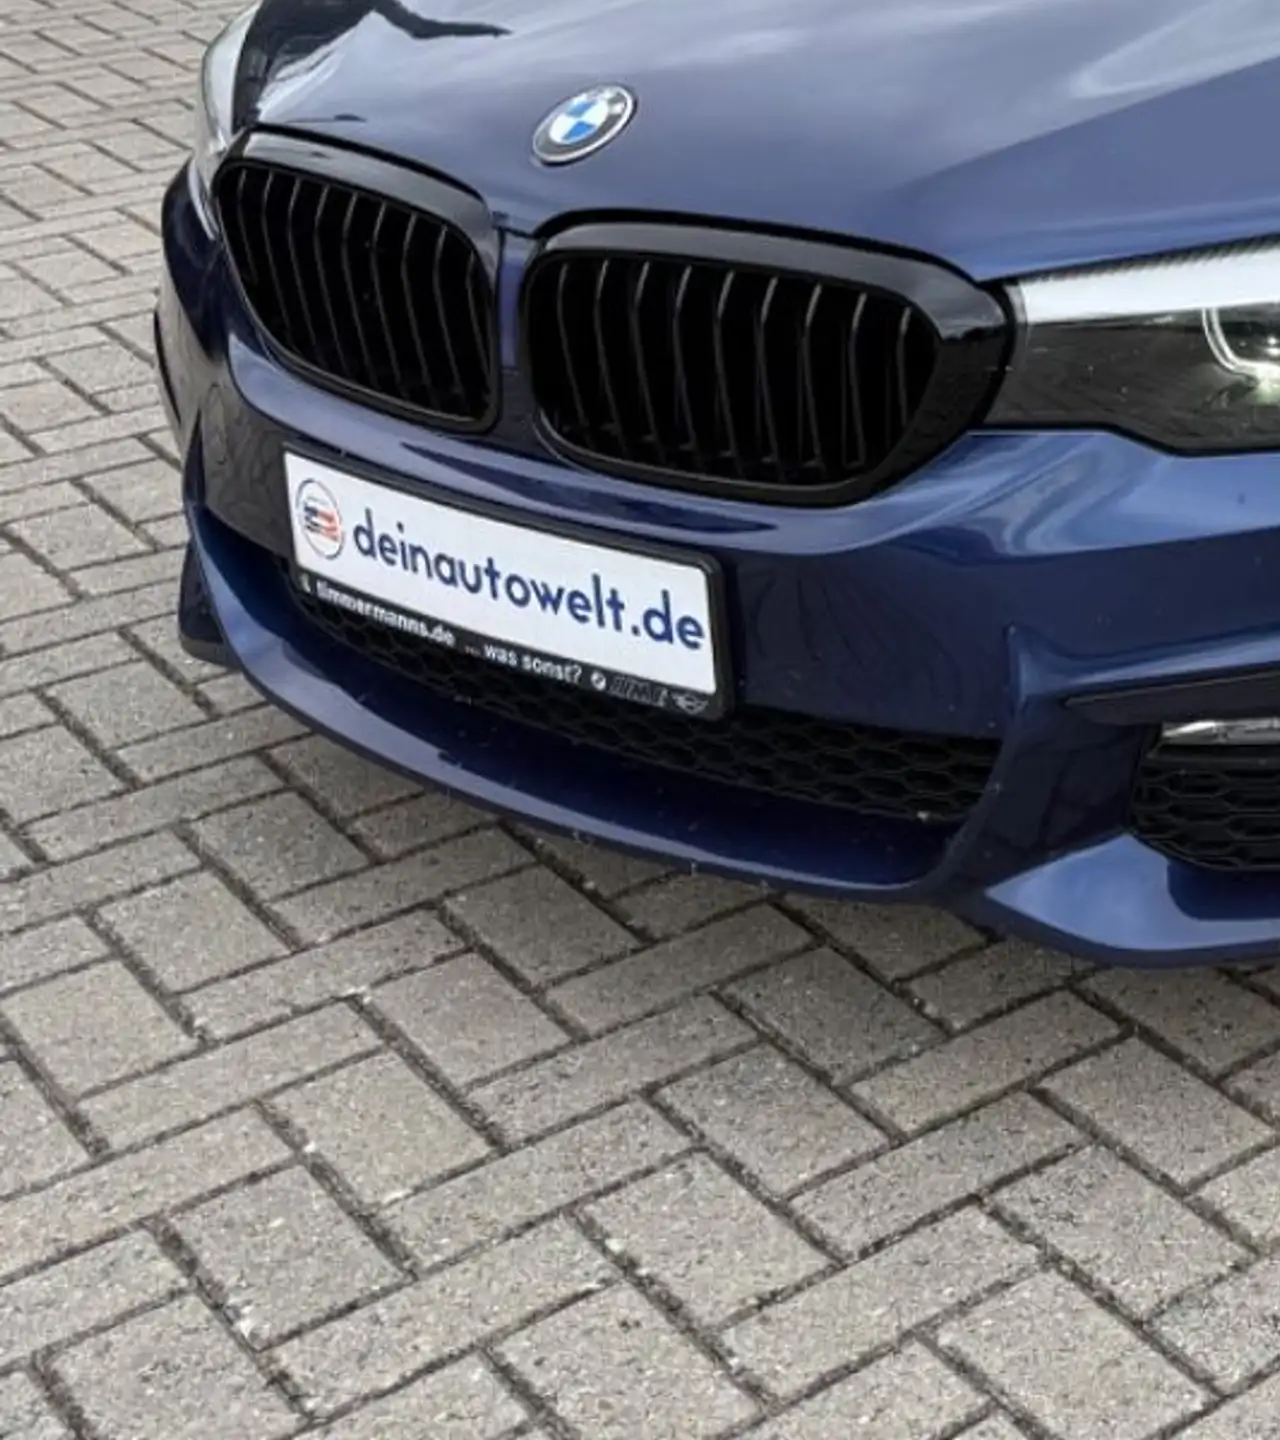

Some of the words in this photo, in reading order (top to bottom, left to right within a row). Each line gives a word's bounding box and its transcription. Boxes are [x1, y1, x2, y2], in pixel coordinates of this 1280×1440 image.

[315, 578, 456, 648] timmermanns.de
[484, 643, 518, 667] was
[521, 652, 584, 684] sonst?
[353, 507, 705, 650] deinautowelt.de
